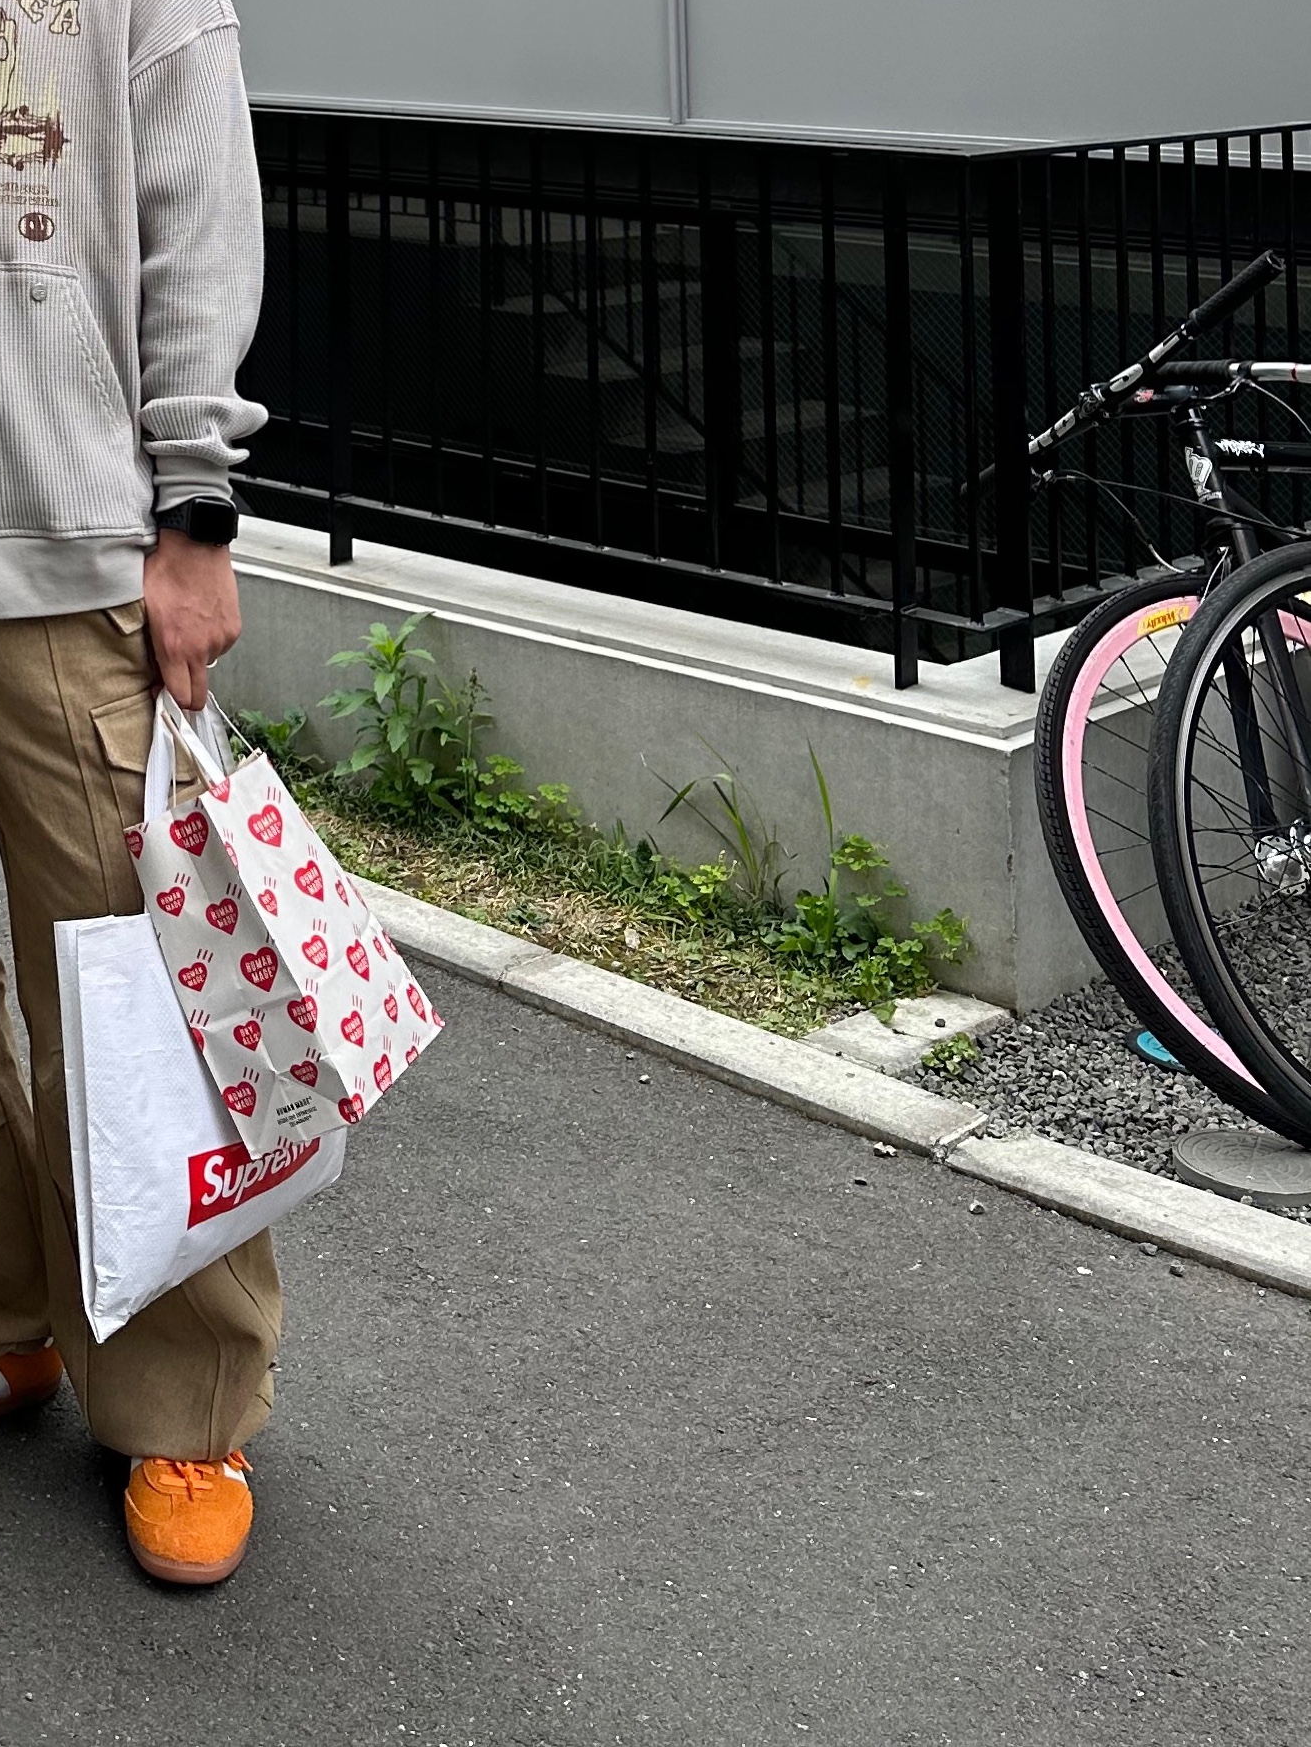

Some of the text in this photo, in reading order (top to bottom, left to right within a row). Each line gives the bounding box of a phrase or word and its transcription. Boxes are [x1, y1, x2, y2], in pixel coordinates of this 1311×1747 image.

[174, 819, 204, 840] HUMAN
[245, 953, 274, 973] HUMAN
[227, 1086, 252, 1102] HUMAN
[201, 1141, 311, 1206] Suprem
